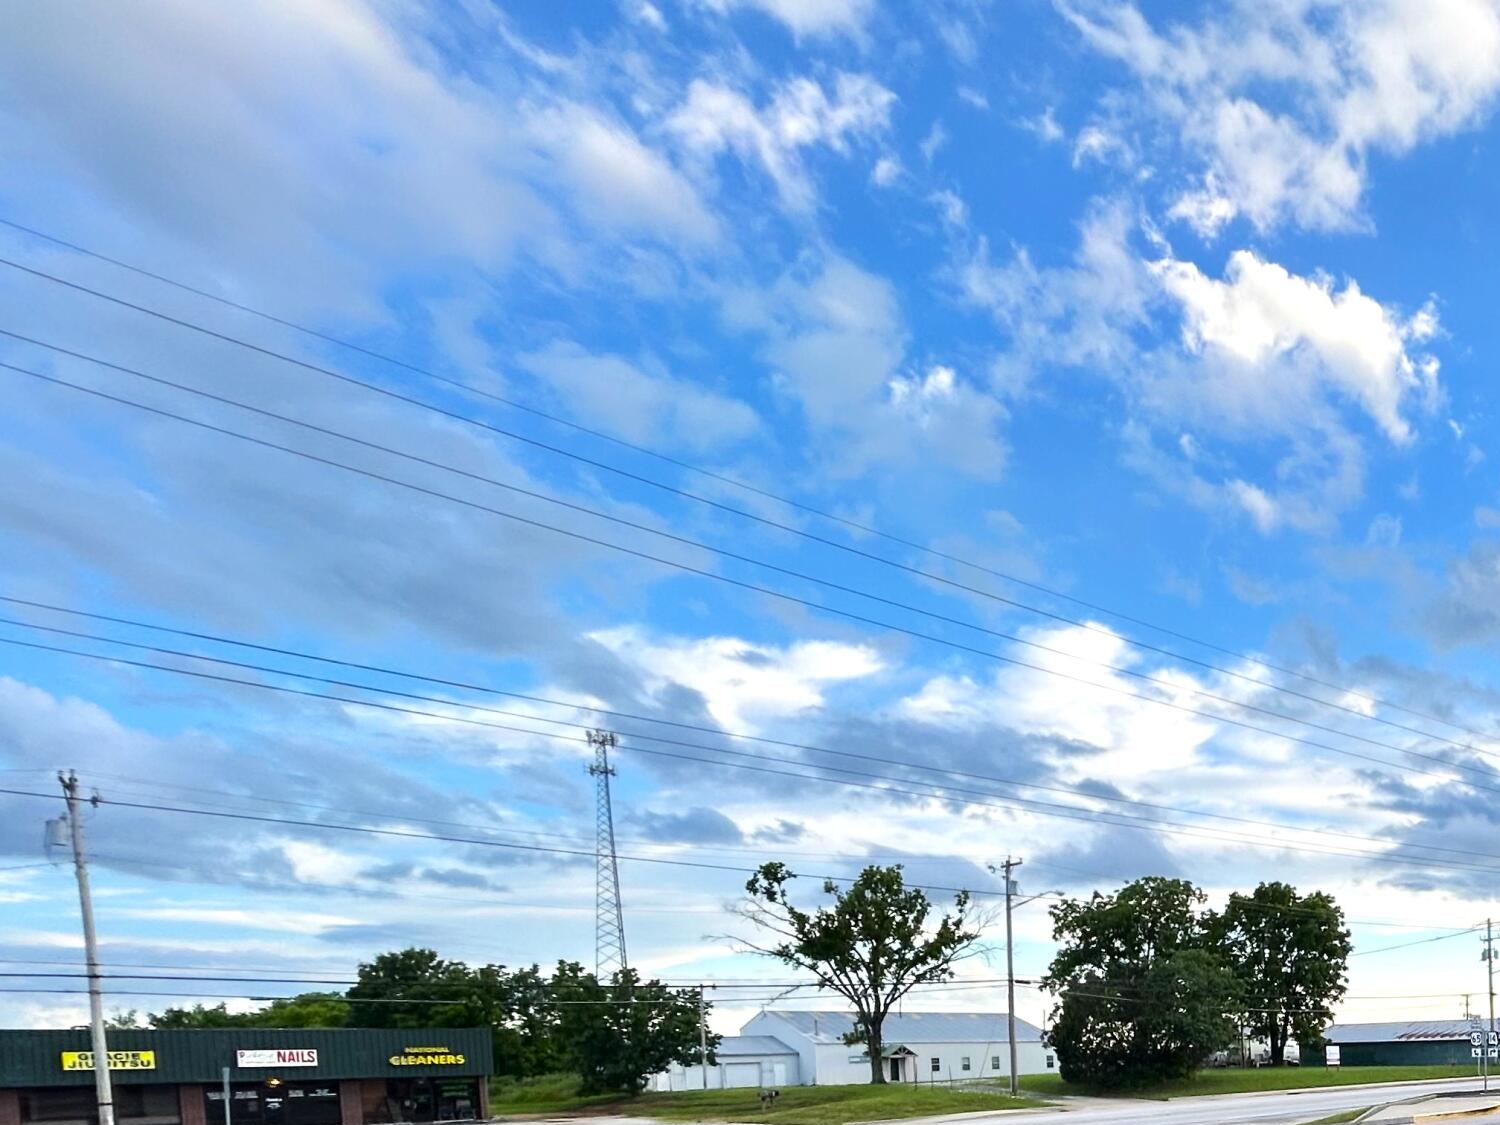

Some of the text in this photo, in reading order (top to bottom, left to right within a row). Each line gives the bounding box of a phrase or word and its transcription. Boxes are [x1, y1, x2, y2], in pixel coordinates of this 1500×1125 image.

[78, 1053, 140, 1061] GCIE
[277, 1051, 315, 1063] NAILS
[389, 1055, 465, 1066] CLEANERS
